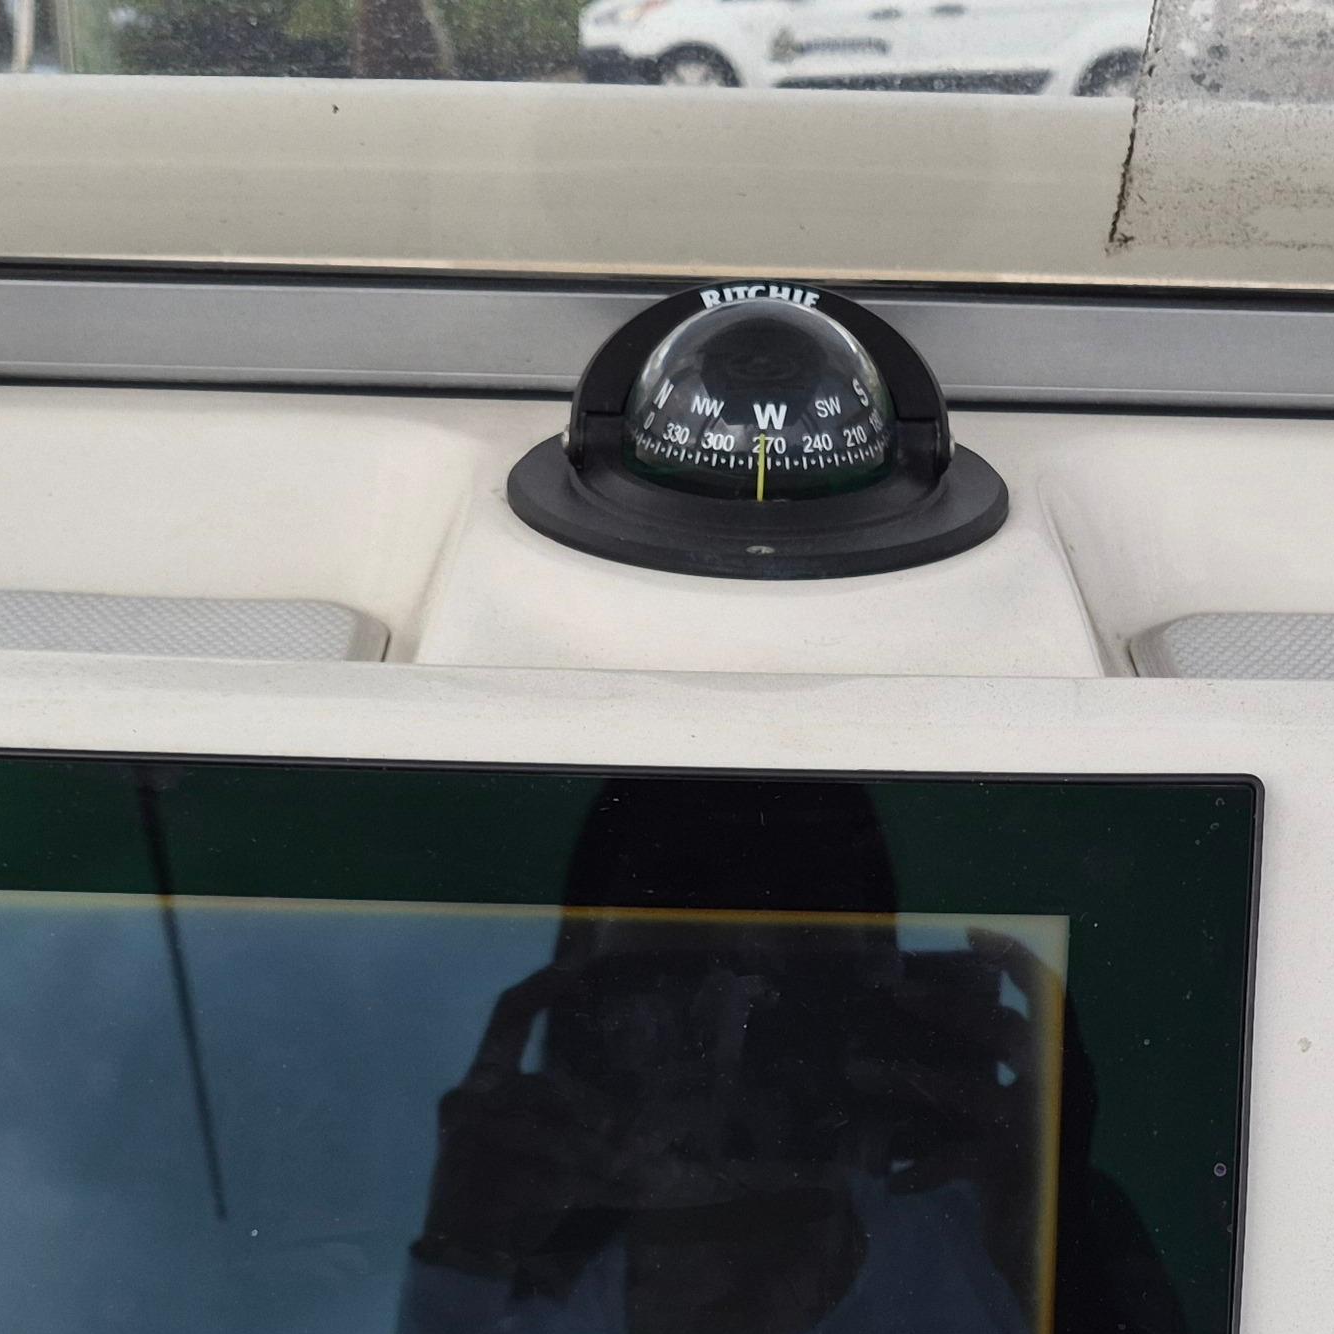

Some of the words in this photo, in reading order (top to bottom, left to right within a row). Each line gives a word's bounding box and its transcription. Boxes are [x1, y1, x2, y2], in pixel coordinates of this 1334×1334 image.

[700, 285, 820, 309] RITCHIE
[653, 378, 674, 409] N
[690, 395, 724, 418] NW
[753, 403, 787, 430] W
[815, 396, 842, 418] SW
[852, 378, 869, 407] S
[662, 422, 690, 444] 330
[701, 432, 735, 451] 300
[752, 436, 787, 454] 270
[802, 433, 833, 453] 240
[843, 426, 867, 447] 210
